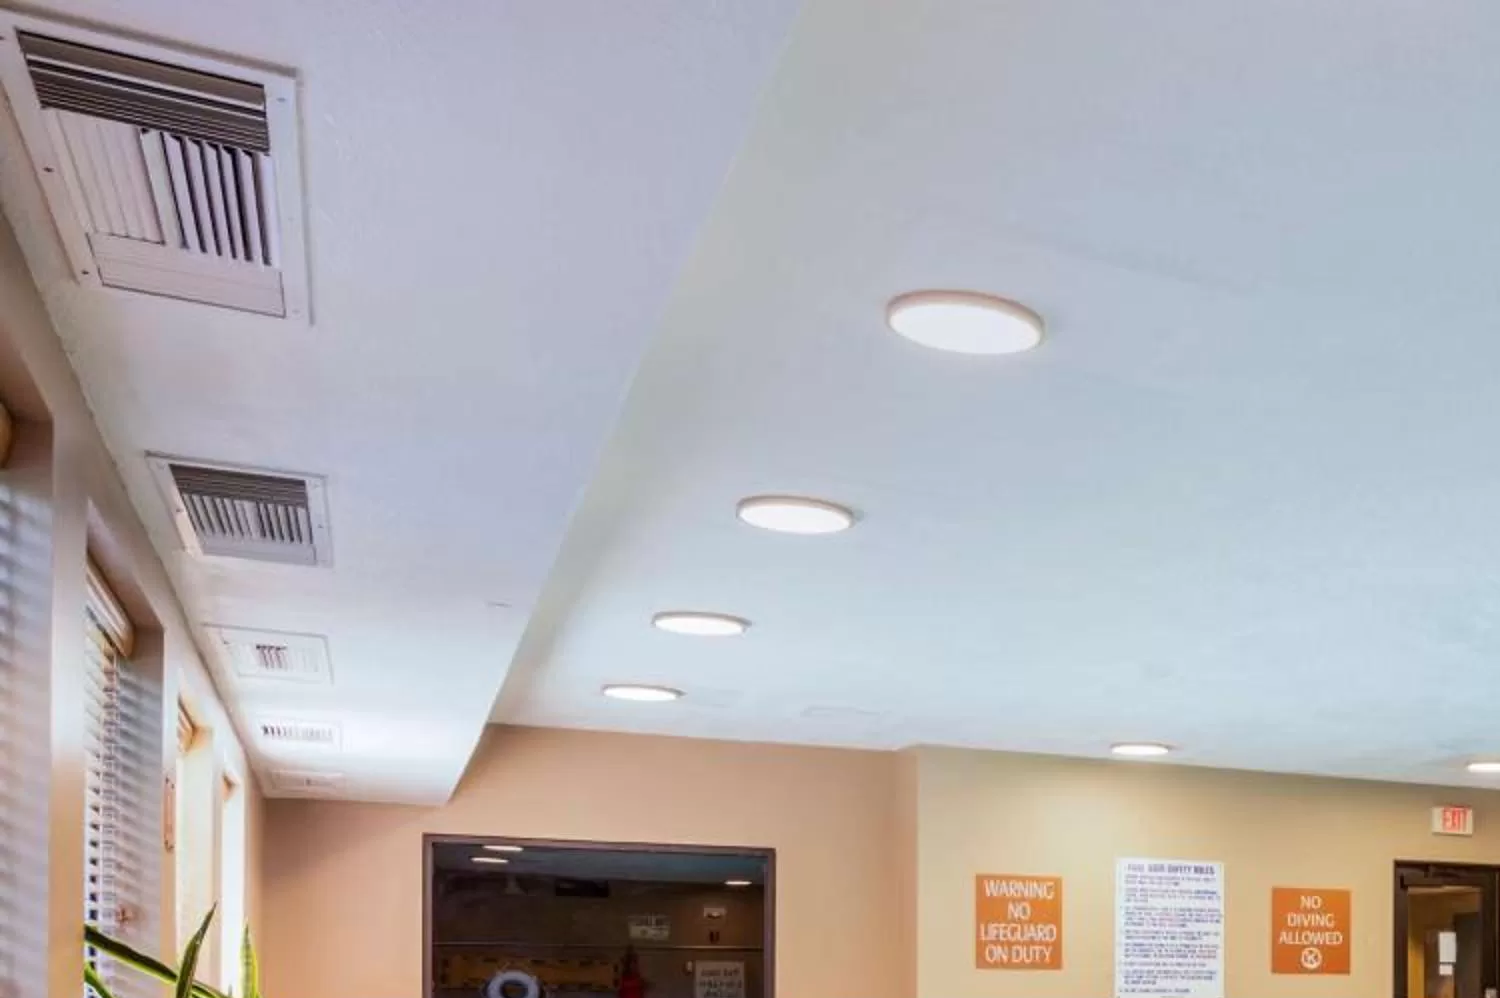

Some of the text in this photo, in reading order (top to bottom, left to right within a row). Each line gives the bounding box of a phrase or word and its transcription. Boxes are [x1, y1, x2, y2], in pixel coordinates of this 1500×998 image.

[1442, 807, 1468, 832] EXIT
[983, 879, 1055, 900] WARNING
[1007, 901, 1032, 921] NO
[1300, 895, 1322, 909] NO
[1287, 911, 1335, 928] DIVING
[980, 922, 1057, 942] LIFEGUARD
[1278, 931, 1343, 945] ALLOWED
[985, 944, 1053, 964] ON DUTY
